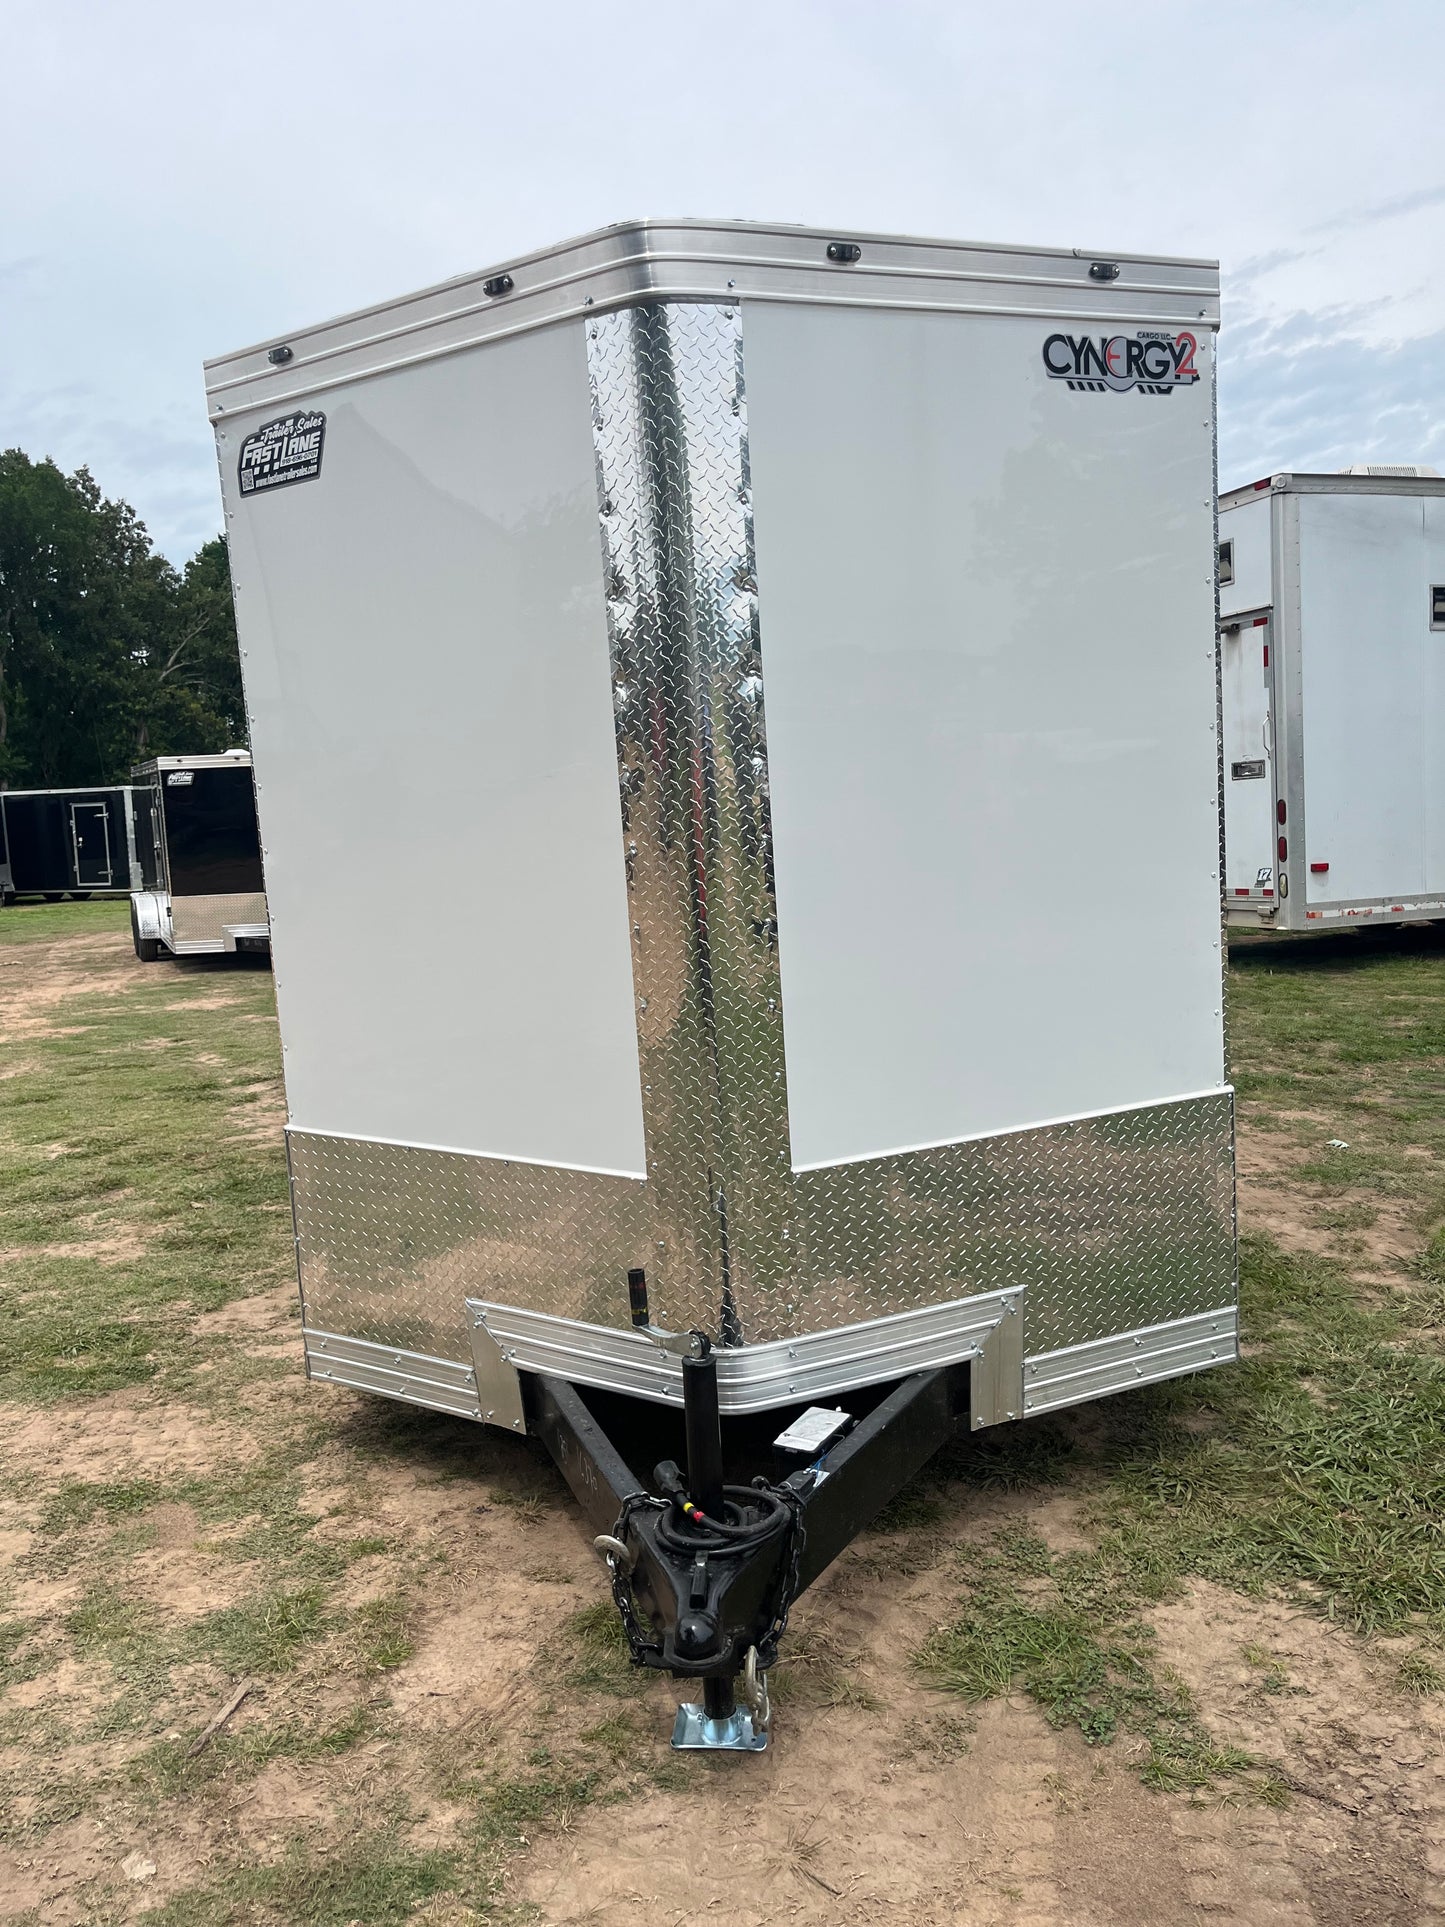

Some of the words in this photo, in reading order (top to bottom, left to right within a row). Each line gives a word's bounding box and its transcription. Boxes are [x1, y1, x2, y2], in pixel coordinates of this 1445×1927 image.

[1137, 331, 1160, 339] CARGO
[262, 424, 294, 443] Trailer
[297, 416, 323, 433] Sales
